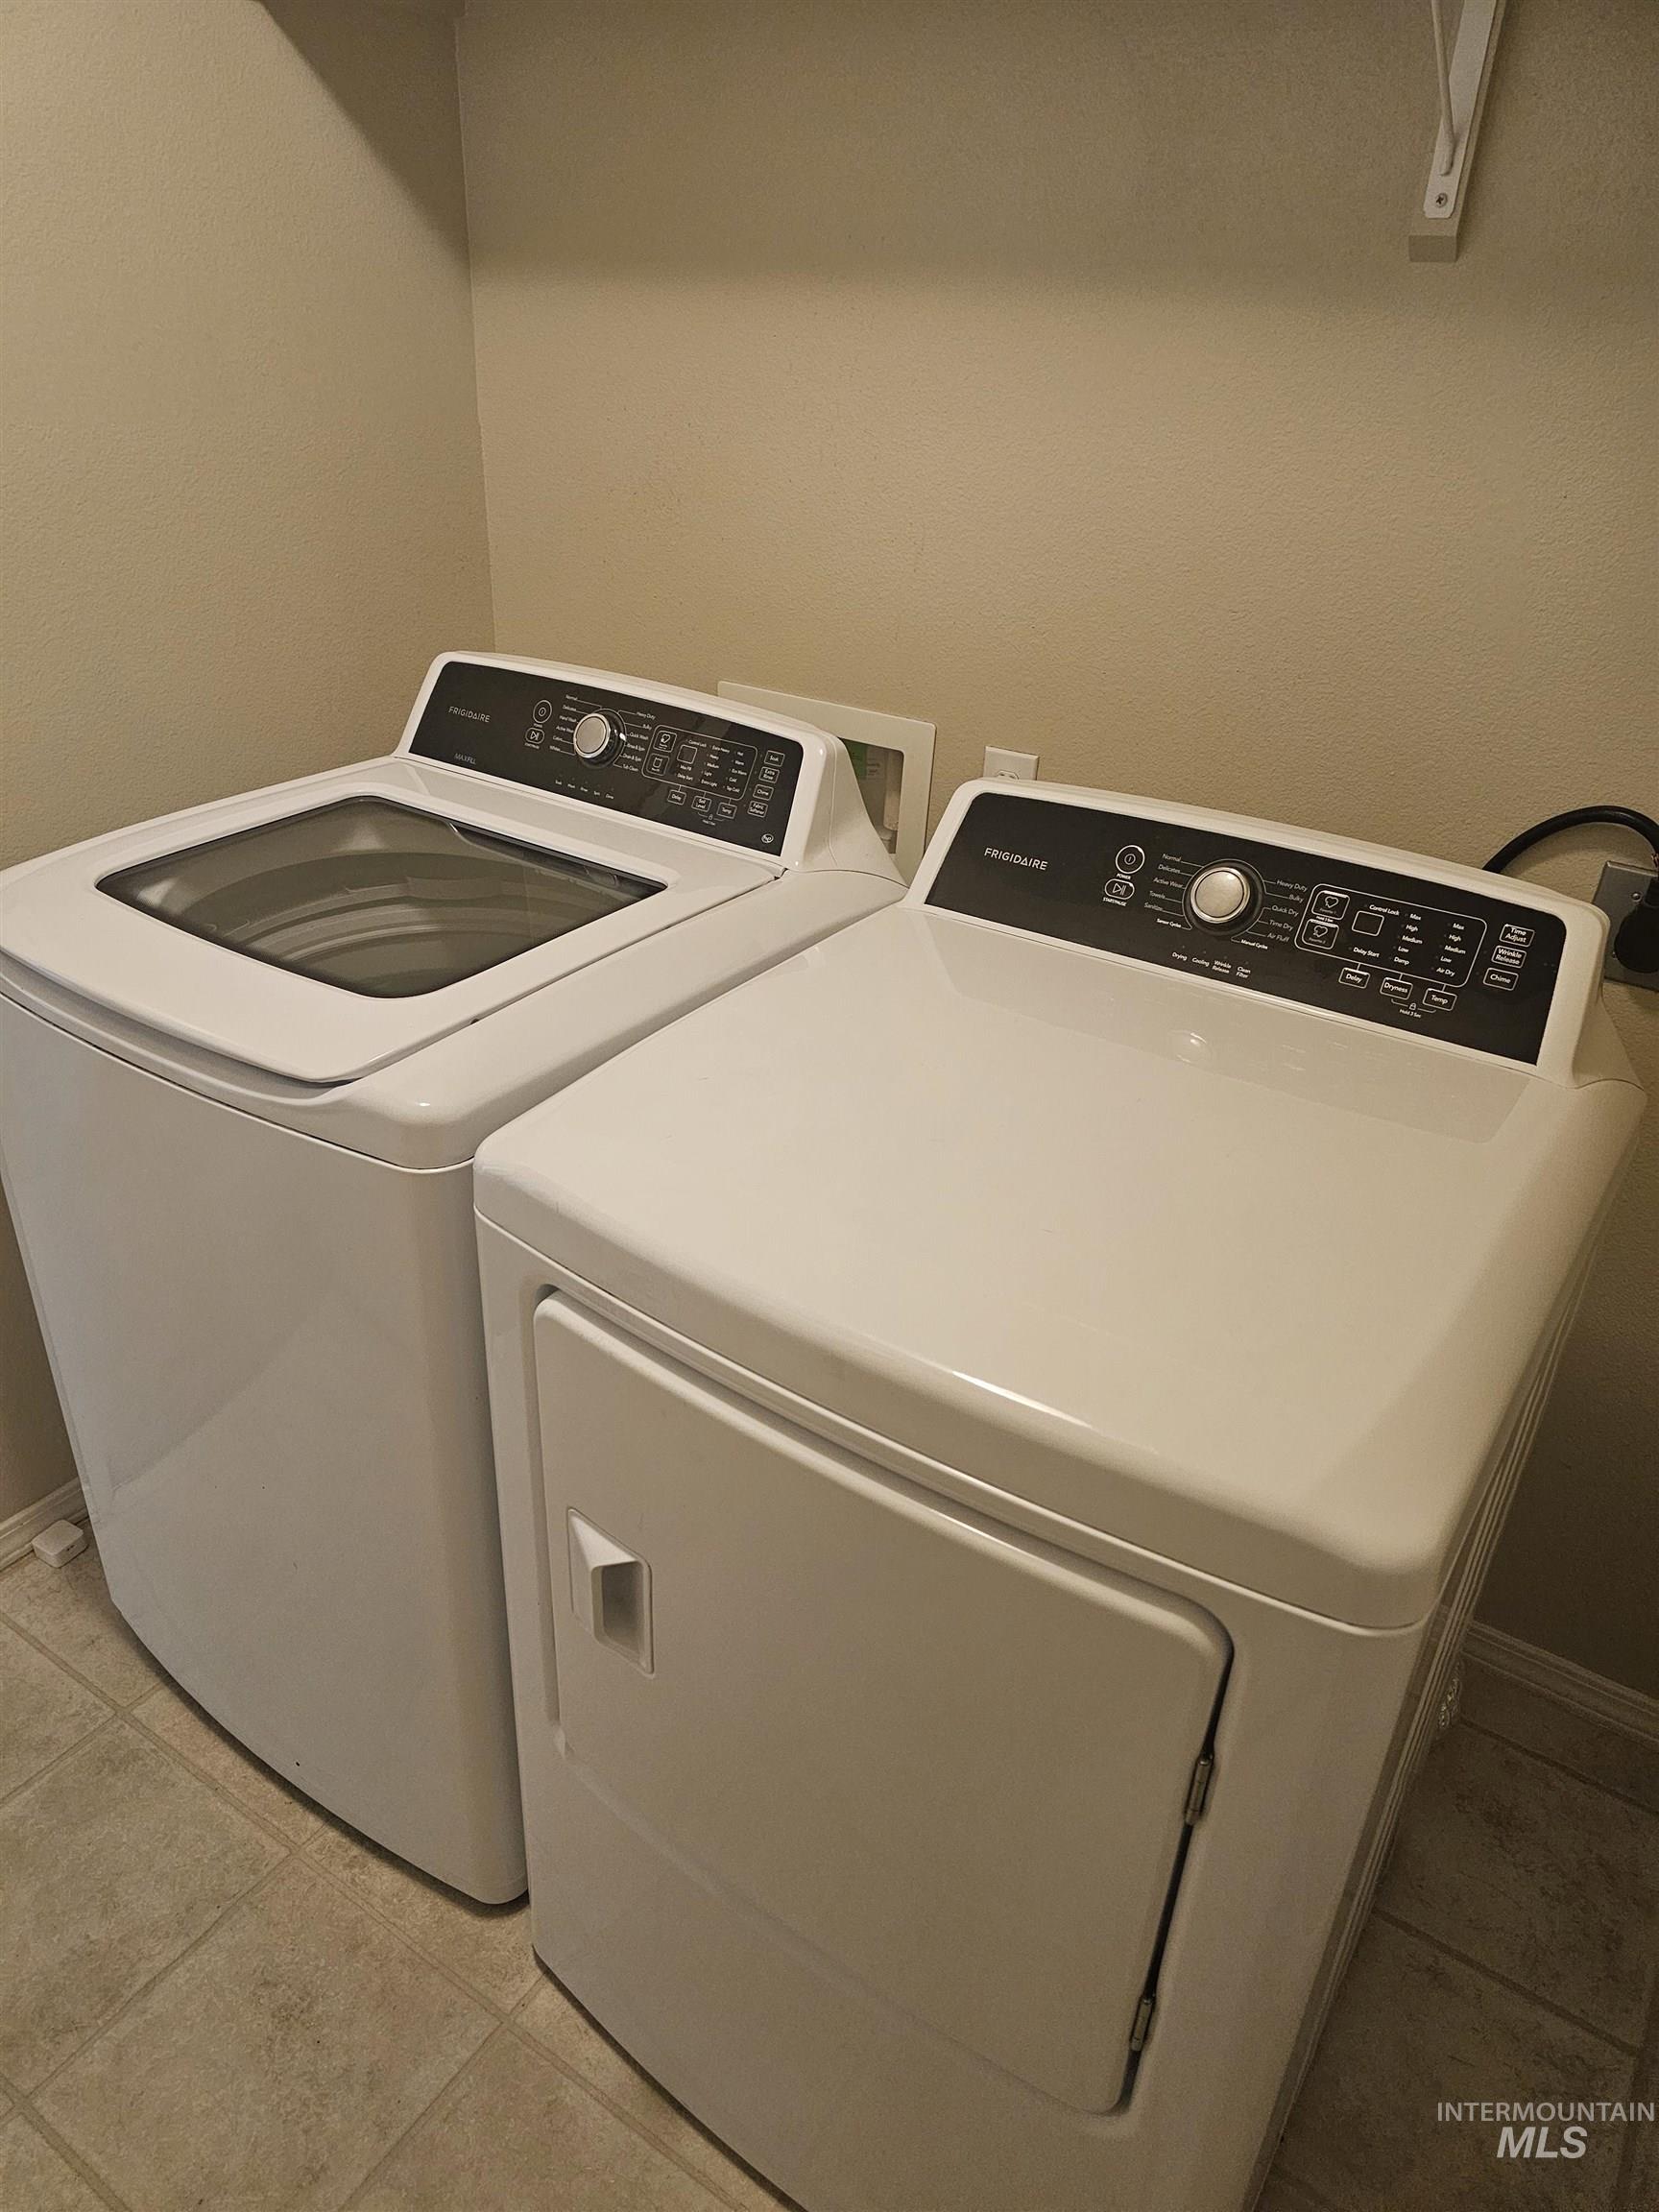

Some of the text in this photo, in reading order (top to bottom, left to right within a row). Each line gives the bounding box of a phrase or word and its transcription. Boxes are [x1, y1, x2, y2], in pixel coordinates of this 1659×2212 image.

[448, 706, 491, 723] FRIGIDAIRE
[984, 847, 1047, 871] FRIGIDAIRE
[1162, 853, 1182, 862] Normal
[1158, 864, 1181, 874] Delicates
[1169, 879, 1184, 888] Wear
[1277, 879, 1308, 893] Heavy Duty
[1149, 891, 1166, 900] Towels
[1288, 894, 1304, 903] Bulky
[1271, 904, 1299, 917] Quick Dry
[1369, 904, 1400, 916] Control Lock
[1269, 919, 1293, 931] Time Dry
[1406, 924, 1419, 932] High
[1453, 923, 1465, 931] Max
[1510, 926, 1527, 936] Time
[1402, 935, 1423, 945] Medium
[1448, 933, 1461, 943] High
[1504, 932, 1527, 944] Adjust
[1353, 947, 1381, 958] Delay Start
[1444, 945, 1467, 954] Medium
[1498, 948, 1523, 959] Wrinkle
[1171, 951, 1188, 961] Drying
[1393, 956, 1410, 966] Damp
[1495, 954, 1521, 966] Release
[1191, 957, 1210, 967] Cooling
[1214, 960, 1232, 969] Wrinkle
[1212, 965, 1230, 974] Release
[1237, 966, 1251, 974] Clean
[1444, 969, 1456, 977] Dry
[1345, 973, 1362, 983] Delay
[1489, 973, 1512, 984] Chime
[1383, 982, 1408, 994] Dryness
[1431, 994, 1449, 1005] Temp
